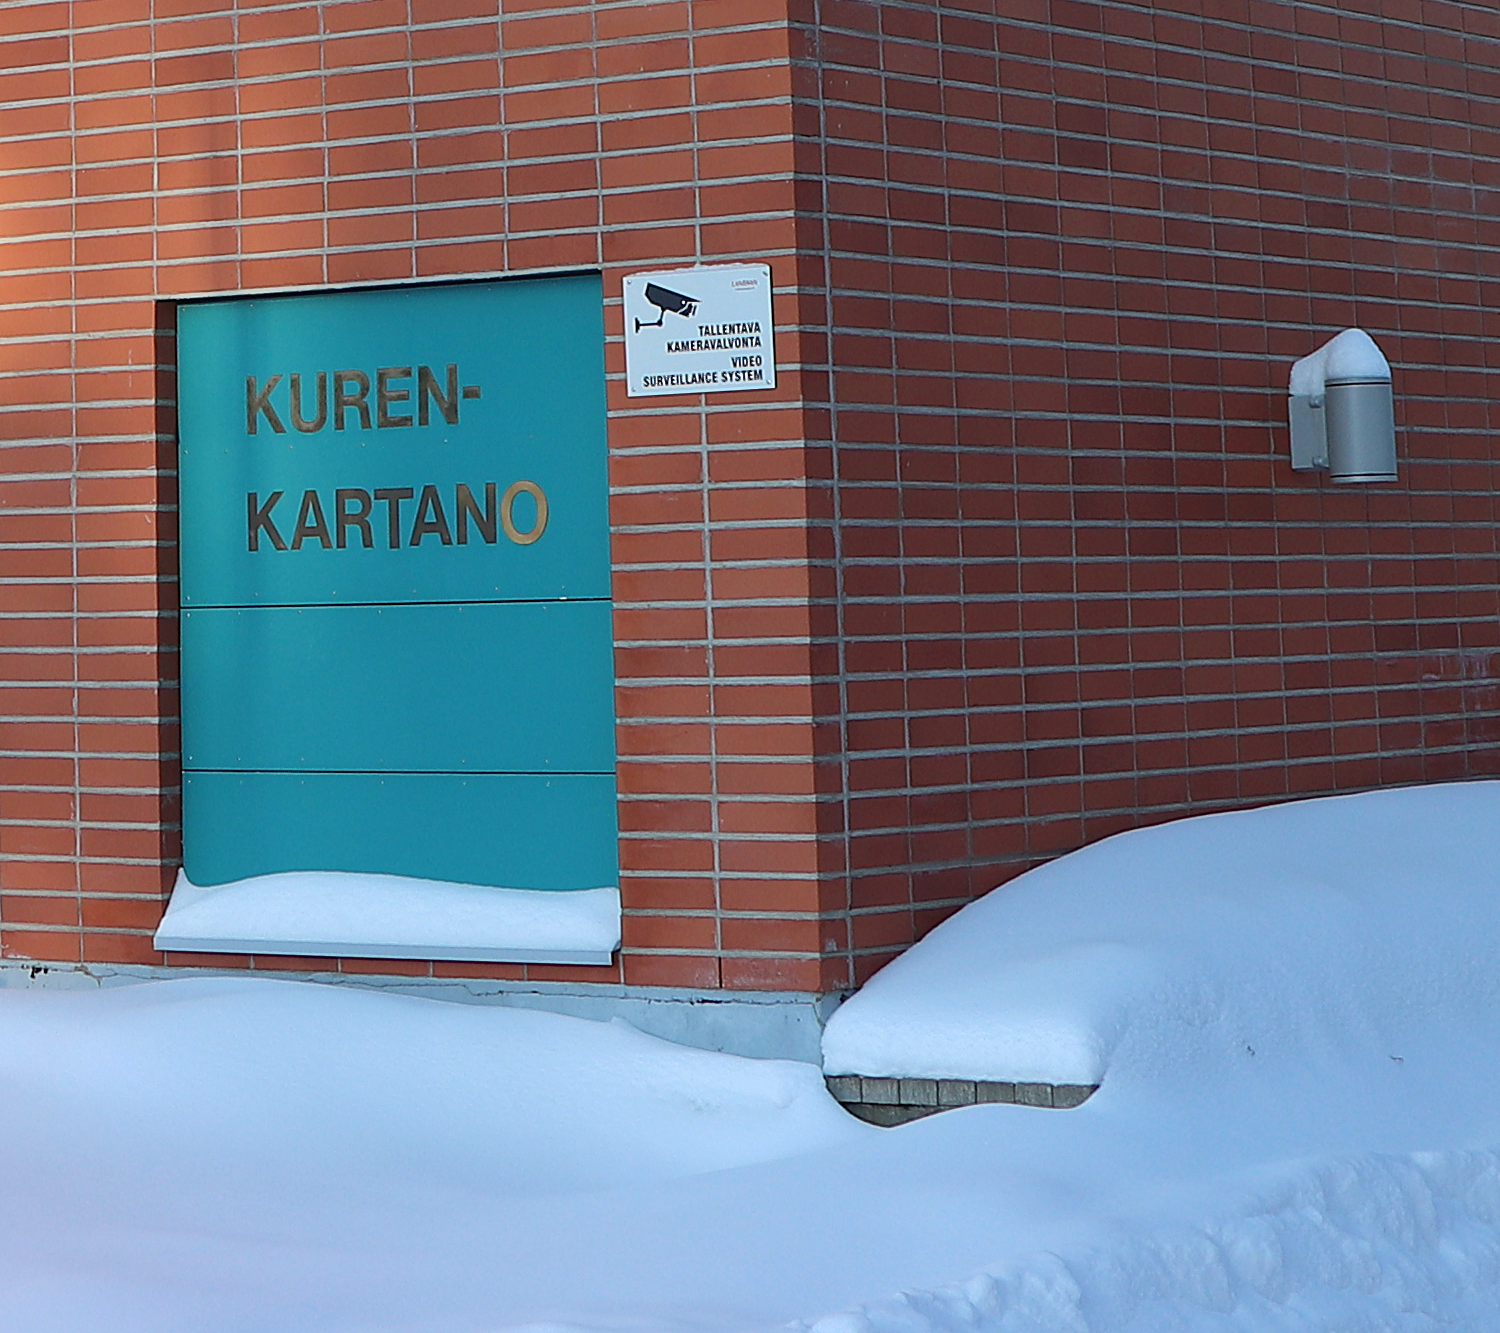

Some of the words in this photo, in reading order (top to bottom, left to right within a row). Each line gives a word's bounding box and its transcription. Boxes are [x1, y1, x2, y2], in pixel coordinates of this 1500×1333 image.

[698, 321, 761, 337] TALLENTAVA
[666, 336, 762, 353] KAMERAVALVONTA
[731, 355, 763, 368] VIDEO
[643, 372, 717, 387] SURVEILLANCE
[721, 369, 763, 383] SYSTEM
[246, 363, 481, 435] KUREN-
[246, 479, 549, 552] KARTANO
